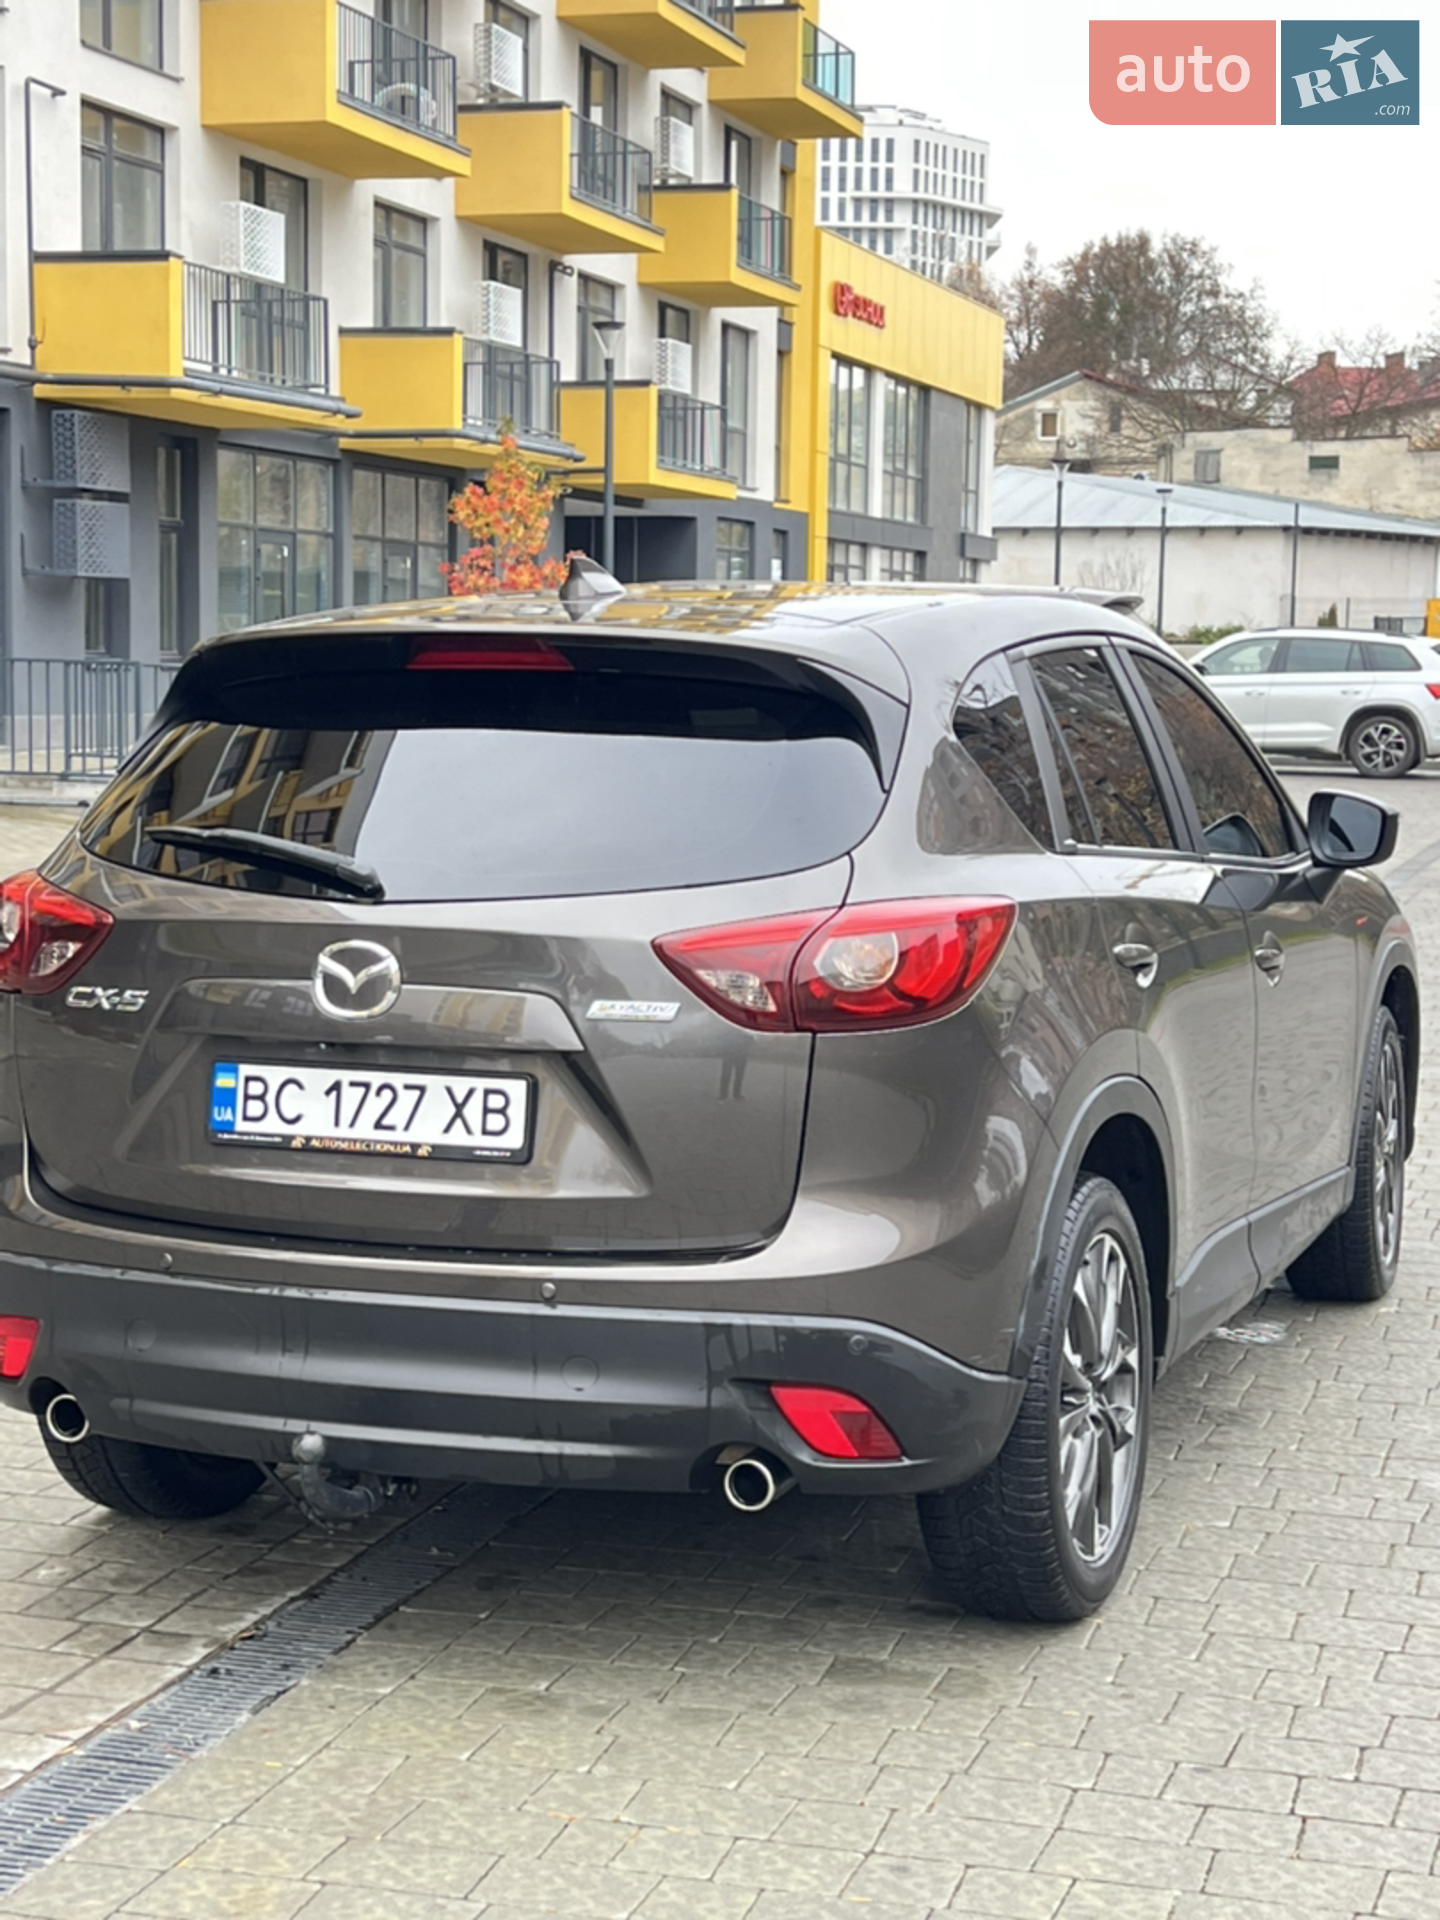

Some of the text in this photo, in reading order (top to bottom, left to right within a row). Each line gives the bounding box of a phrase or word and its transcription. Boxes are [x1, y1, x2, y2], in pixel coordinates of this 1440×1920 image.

[65, 986, 150, 1013] CX-5
[213, 1106, 234, 1123] UA
[242, 1075, 511, 1137] BC 1727 XB
[310, 1137, 412, 1154] AUTOSELECTION.UA
